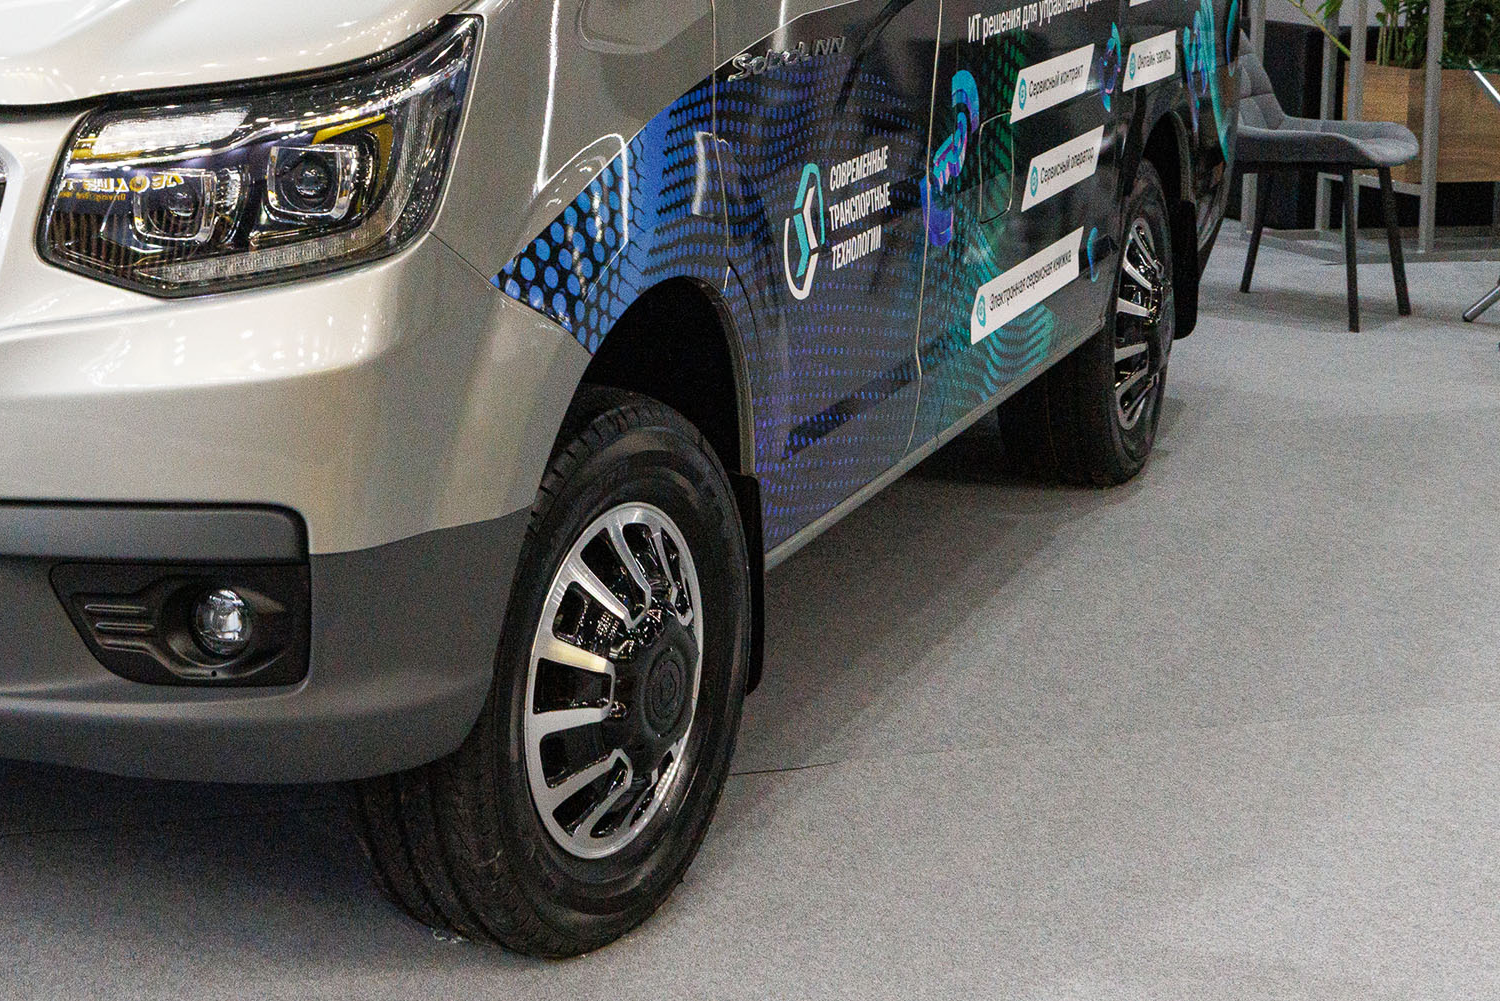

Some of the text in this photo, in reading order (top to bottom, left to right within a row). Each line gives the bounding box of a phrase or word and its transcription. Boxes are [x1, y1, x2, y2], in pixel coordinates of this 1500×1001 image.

[967, 13, 981, 43] ИТ
[982, 7, 1021, 46] решения
[1021, 2, 1038, 30] для
[1028, 65, 1084, 98] Сервисный контракт
[829, 145, 889, 192] СОВРЕМЕННЫЕ
[1040, 155, 1070, 184] Сервисный
[829, 182, 891, 231] ТРАНСПОРТНЫЕ
[831, 224, 882, 271] ТЕХНОЛОГИИ
[988, 278, 1026, 312] Электронная
